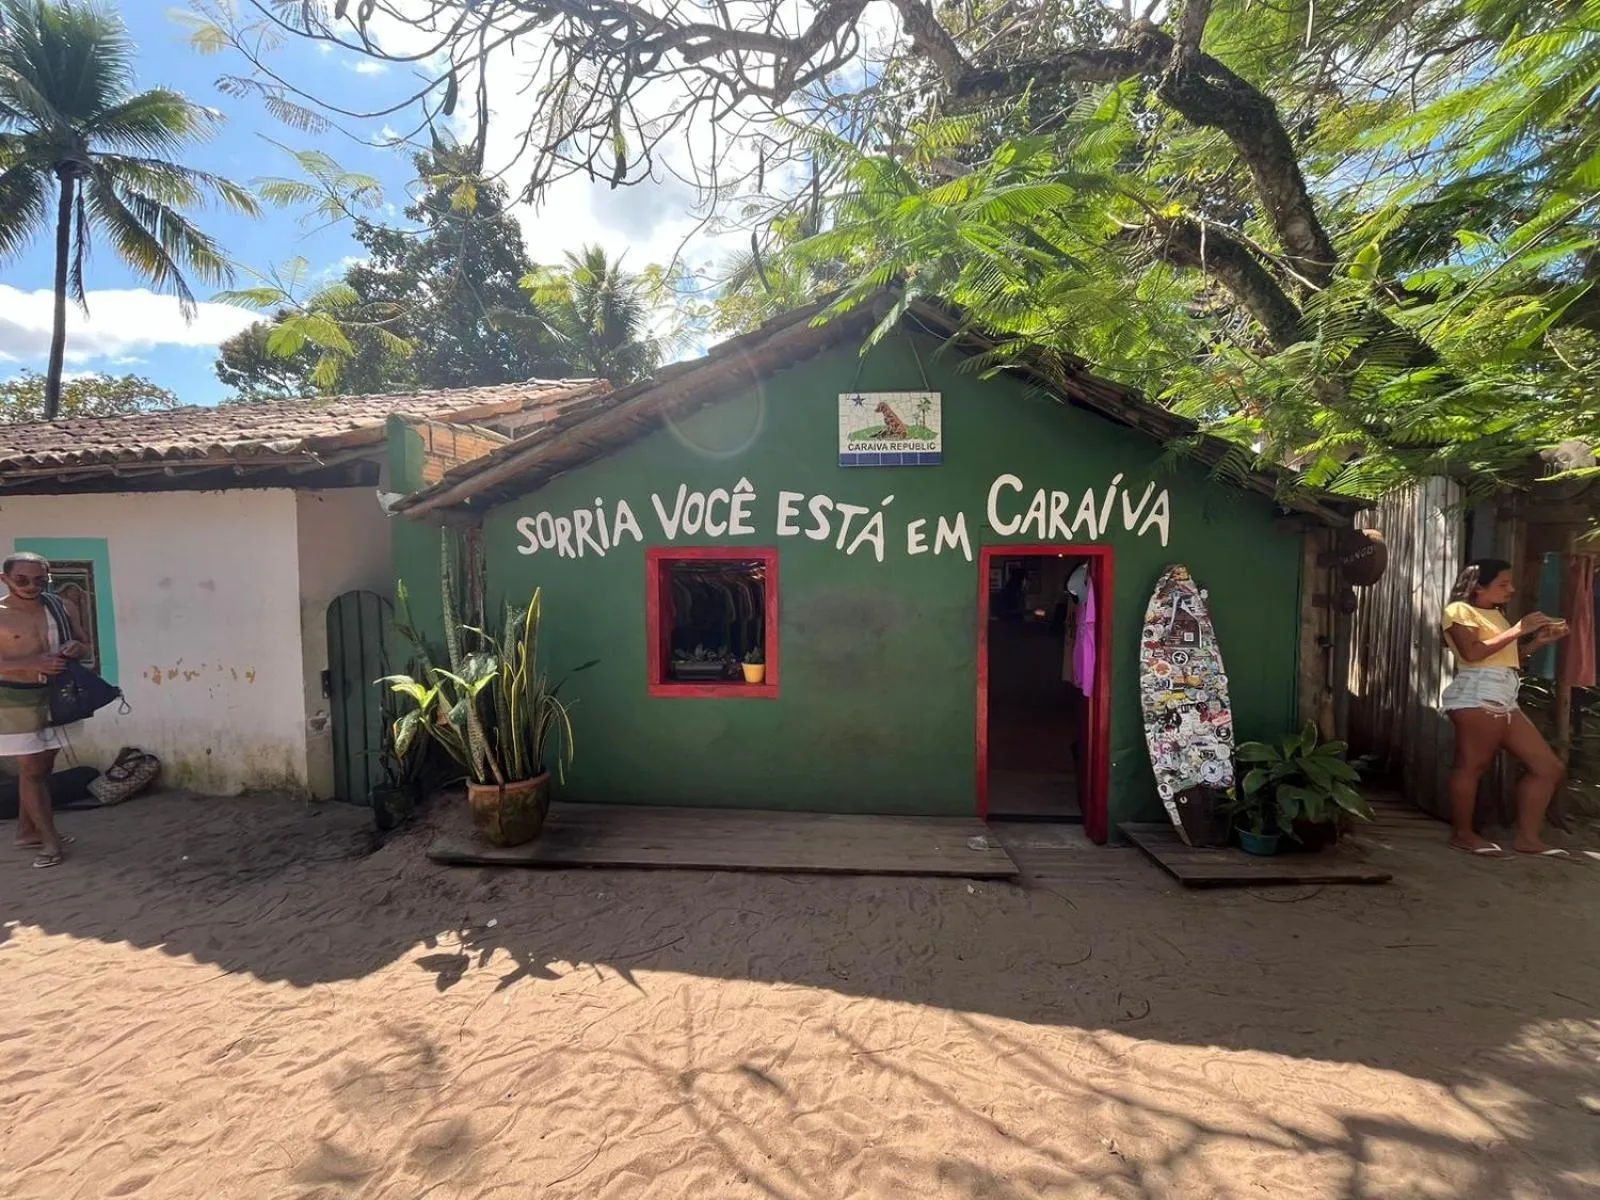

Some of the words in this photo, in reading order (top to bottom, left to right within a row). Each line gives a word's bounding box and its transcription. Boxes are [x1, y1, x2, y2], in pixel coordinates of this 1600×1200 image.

[848, 442, 888, 452] CARAIVA
[890, 441, 936, 451] REPUBLIC
[651, 476, 757, 541] VOCÊ
[776, 491, 895, 563] ESTÁ
[907, 511, 973, 562] EM
[987, 473, 1170, 547] CARAÍVA
